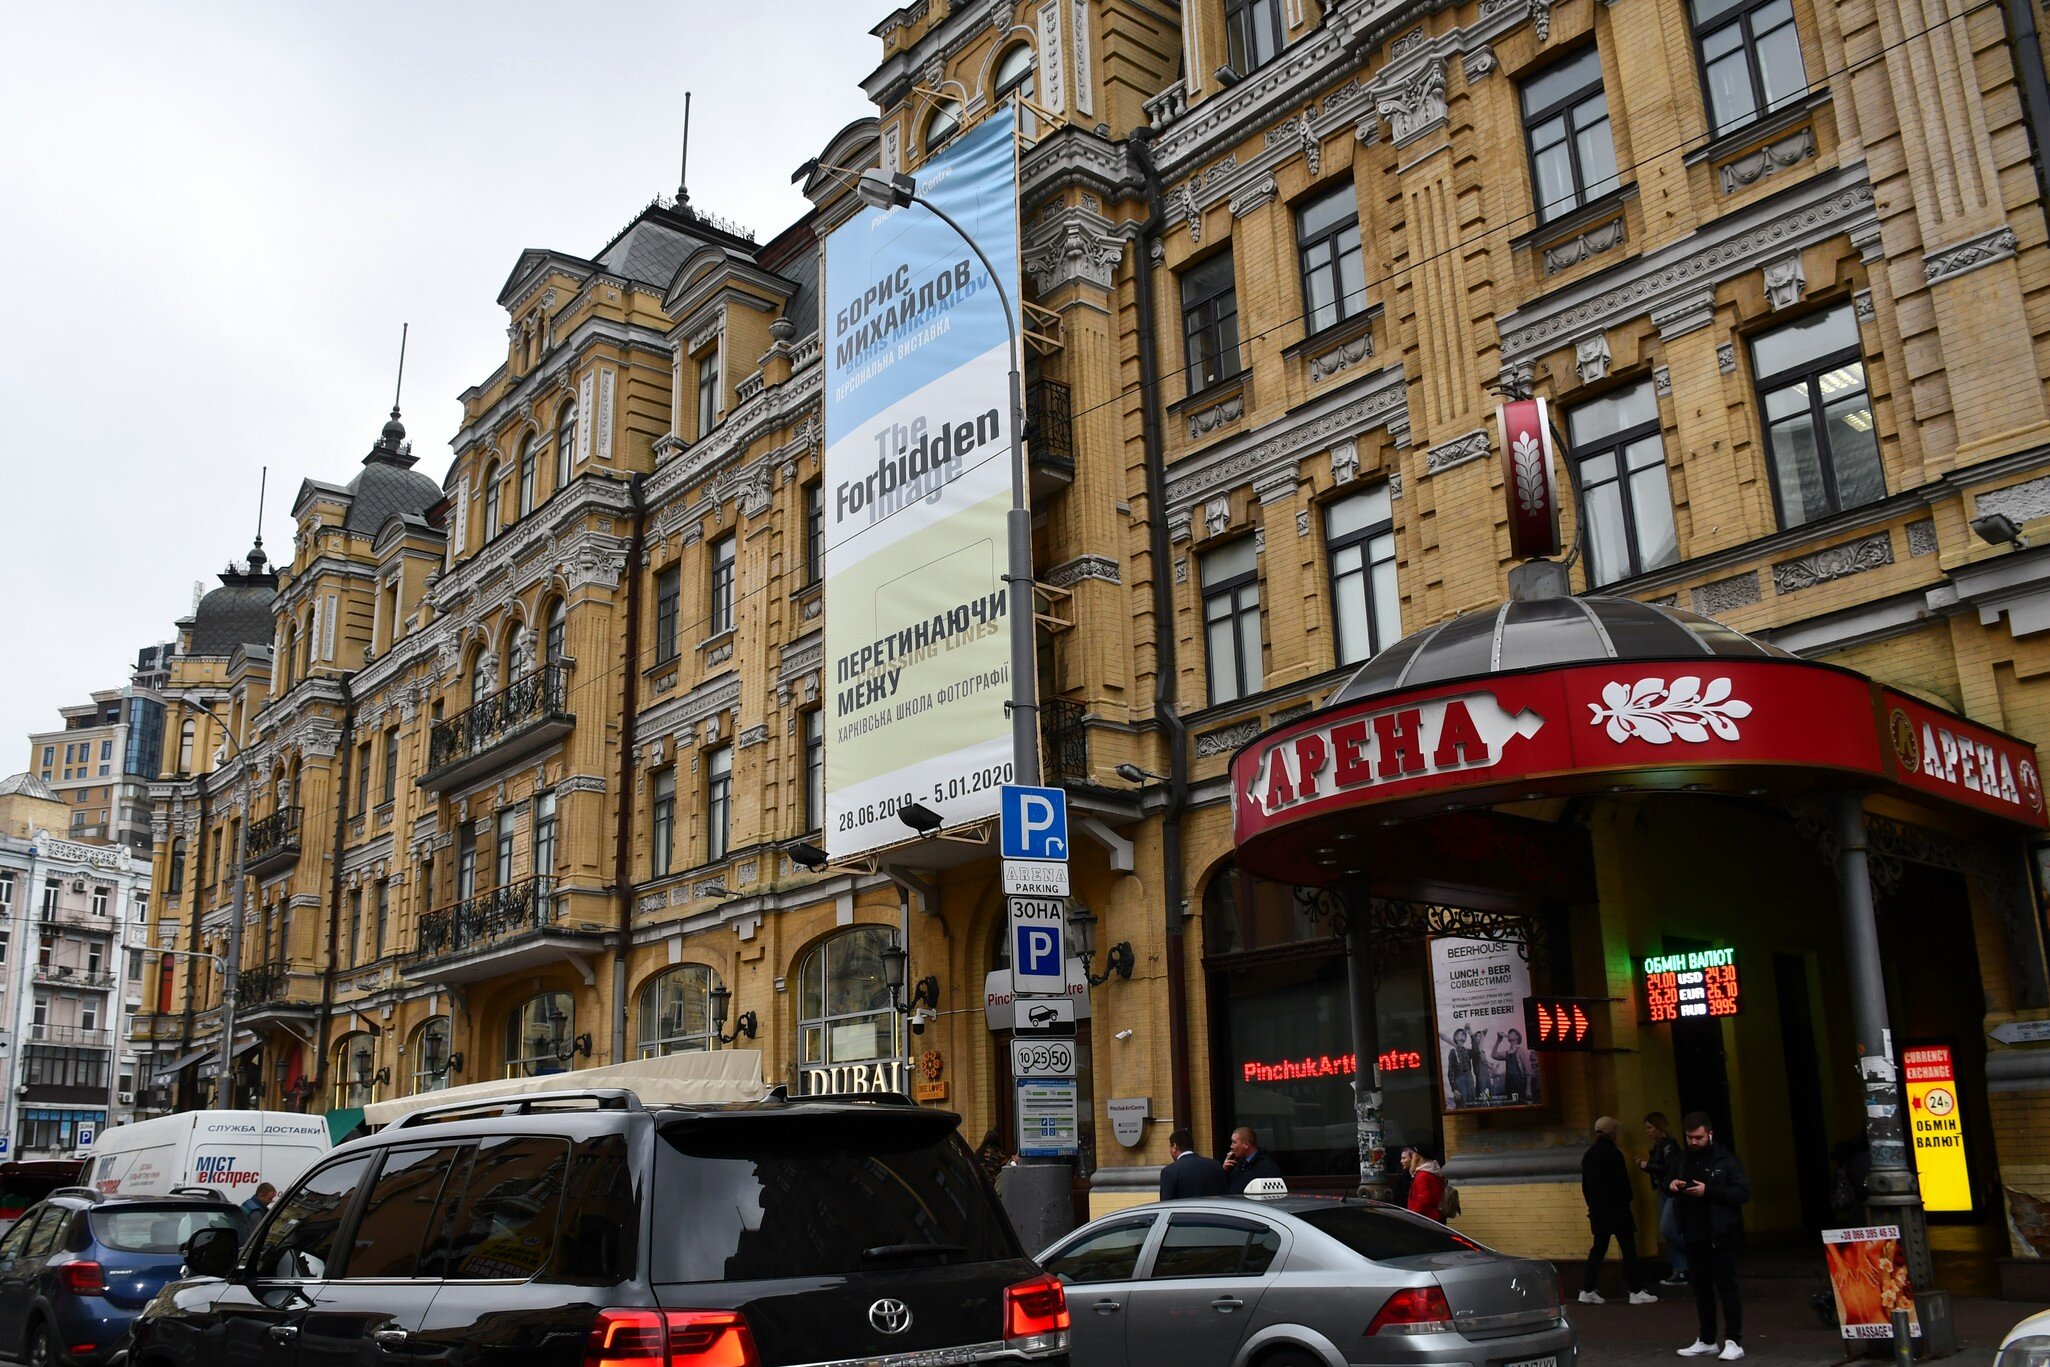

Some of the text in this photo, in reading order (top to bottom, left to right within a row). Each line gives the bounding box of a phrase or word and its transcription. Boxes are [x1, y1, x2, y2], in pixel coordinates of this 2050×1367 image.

[837, 264, 908, 337] БОРИС
[837, 259, 970, 370] МИХАЙЛОВ
[846, 272, 988, 375] BORIS MIKHAILOV
[836, 317, 950, 403] ПЕРСОНАЛЬНА ВИСТАВКА
[874, 416, 927, 458] The
[836, 408, 999, 523] Forbidden
[869, 455, 963, 525] Image
[837, 589, 1006, 684] ПЕРЕТИНАЮЧИ
[945, 618, 999, 651] LINES
[837, 667, 901, 717] МЕЖУ
[837, 661, 1008, 743] ХАРКІВСЬКА ШКОЛА ФОТОГРАФІЇ
[1266, 701, 1490, 809] АРЕНА
[1922, 722, 2020, 804] АРЕНА
[839, 793, 913, 832] 28.06.2019
[934, 762, 1013, 804] 5.01.2020
[1020, 794, 1054, 851] P
[1006, 867, 1067, 882] ARENA
[1016, 883, 1059, 894] PARKING
[1013, 901, 1061, 920] ЗОНА
[1029, 931, 1052, 970] P
[1448, 942, 1509, 958] BEERHOUSE
[1644, 948, 1734, 974] ОБМІН ВАЛЮТ
[1450, 968, 1479, 980] LUNCH
[1488, 965, 1511, 975] BEER
[1677, 972, 1703, 984] USD
[1450, 975, 1512, 989] СОВМЕСТИМО!
[1648, 988, 1678, 1005] 26.20
[1679, 987, 1705, 1000] EUR
[1453, 1005, 1514, 1019] GET FREE BEER!
[1681, 1003, 1707, 1016] RUB
[1019, 1051, 1068, 1066] 10 25 50
[1244, 1049, 1421, 1082] PinchukArtntre
[1904, 1050, 1948, 1064] CURRENCY
[809, 1062, 900, 1095] DUBAI
[1906, 1065, 1950, 1079] EXCHANGE
[918, 1084, 928, 1093] ONE
[208, 1125, 320, 1134] СЛУЖБА ДОСТАВКИ
[1916, 1120, 1956, 1131] ОБМІН
[82, 1133, 90, 1143] P
[1917, 1135, 1960, 1148] ВАЛЮТ
[196, 1157, 236, 1172] МІСТ
[199, 1170, 260, 1188] експрес
[1889, 1227, 1897, 1237] 52
[1856, 1326, 1889, 1338] MASSAGE
